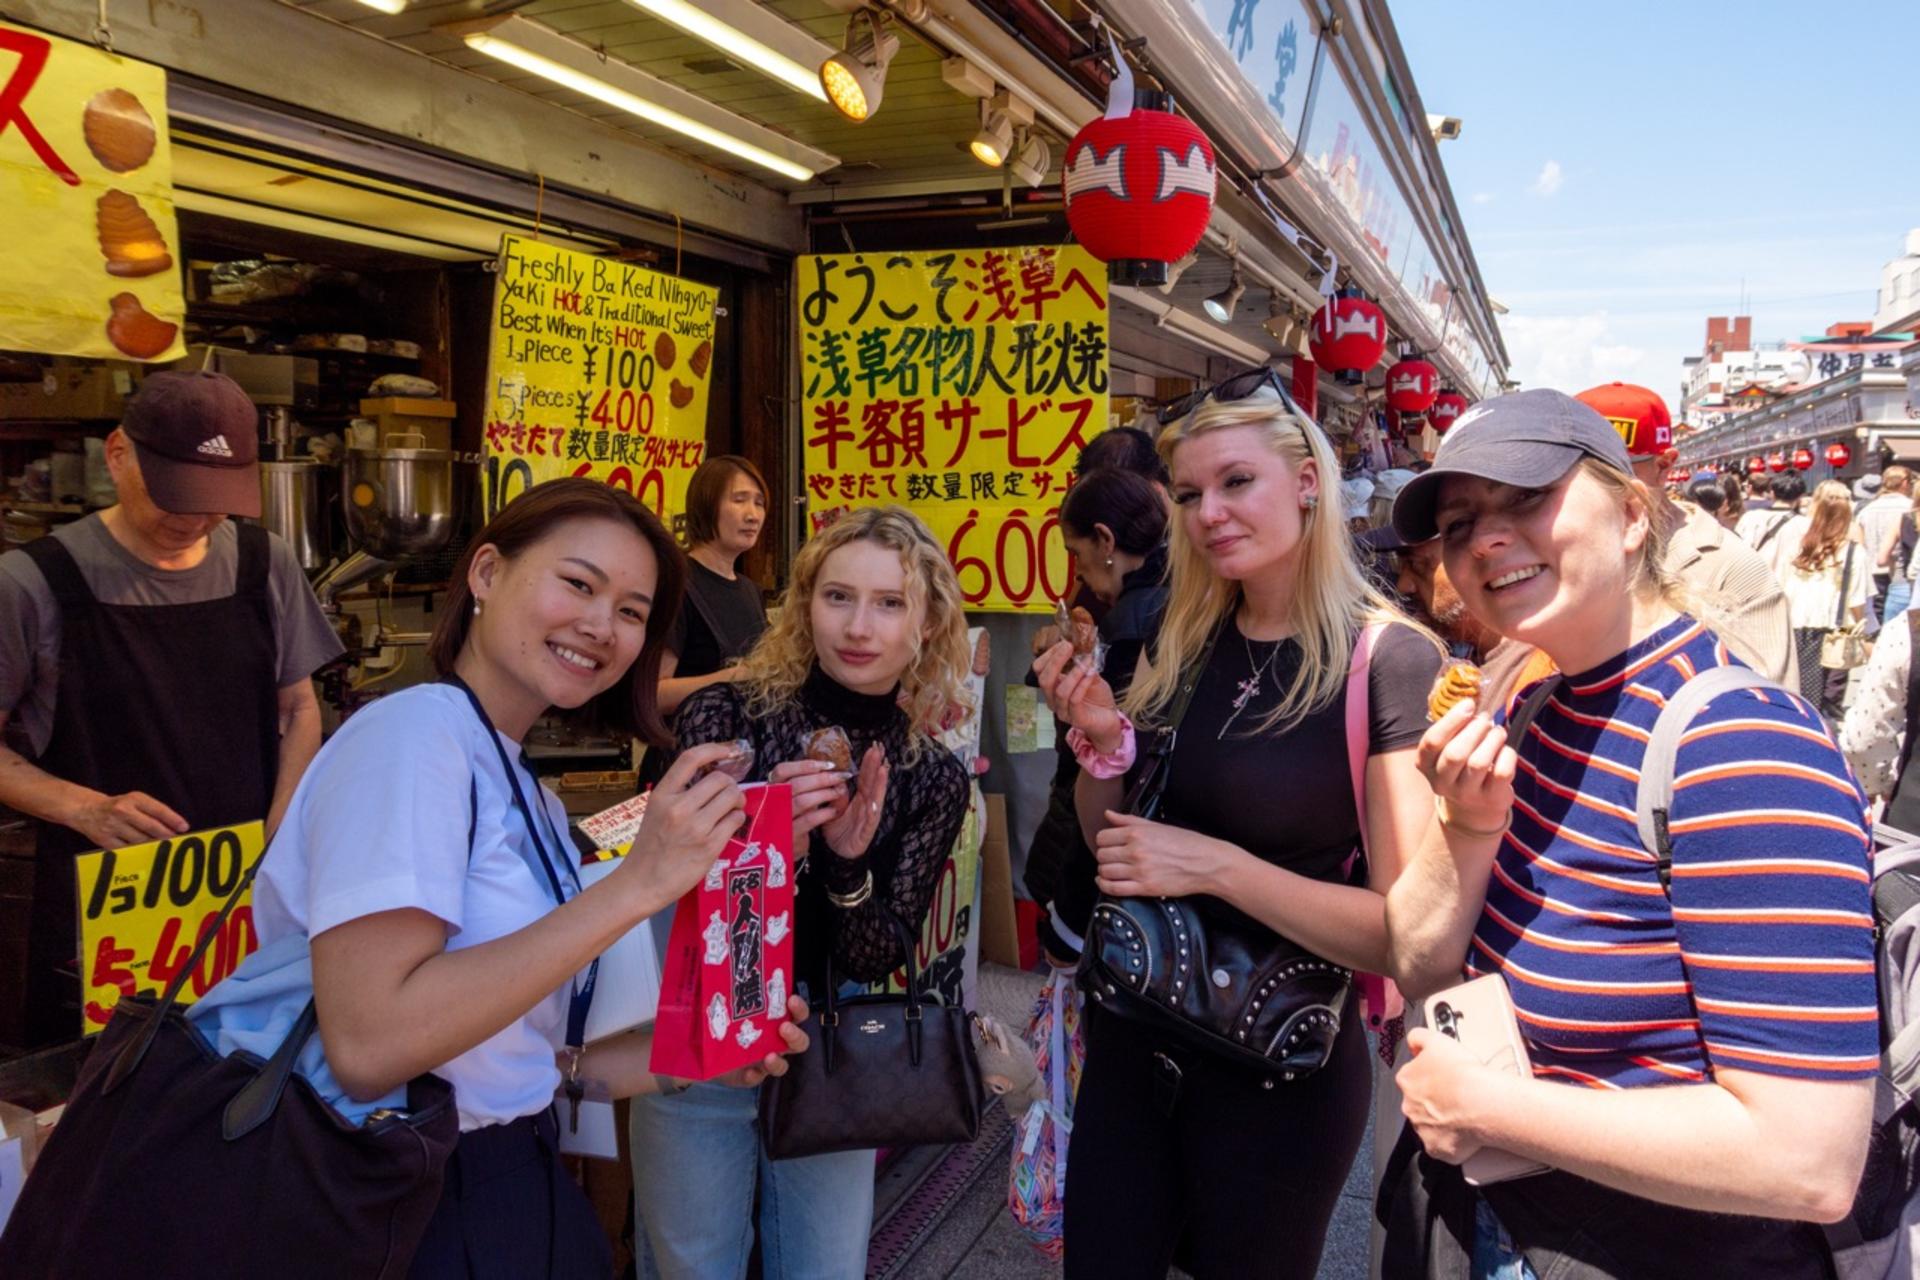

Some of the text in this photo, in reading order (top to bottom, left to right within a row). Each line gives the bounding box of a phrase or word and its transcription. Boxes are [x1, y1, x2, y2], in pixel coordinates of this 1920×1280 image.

[504, 238, 585, 293] Freshly
[803, 248, 1106, 326] ようこそ浅草へ
[500, 303, 543, 334] Best
[546, 314, 588, 342] When
[591, 321, 614, 346] It's
[597, 295, 672, 329] Traditional
[673, 310, 713, 340] Sweet
[523, 339, 574, 364] Piece
[583, 344, 655, 393] ¥100
[805, 321, 1108, 399] 浅草名物人形焼
[575, 388, 655, 435] ¥400
[808, 398, 1094, 470] 半額サービス
[486, 419, 566, 457] やきたて
[566, 427, 645, 466] 数量限定
[808, 472, 899, 500] やきたて
[906, 471, 1029, 501] 数量限定
[948, 518, 1077, 603] 600
